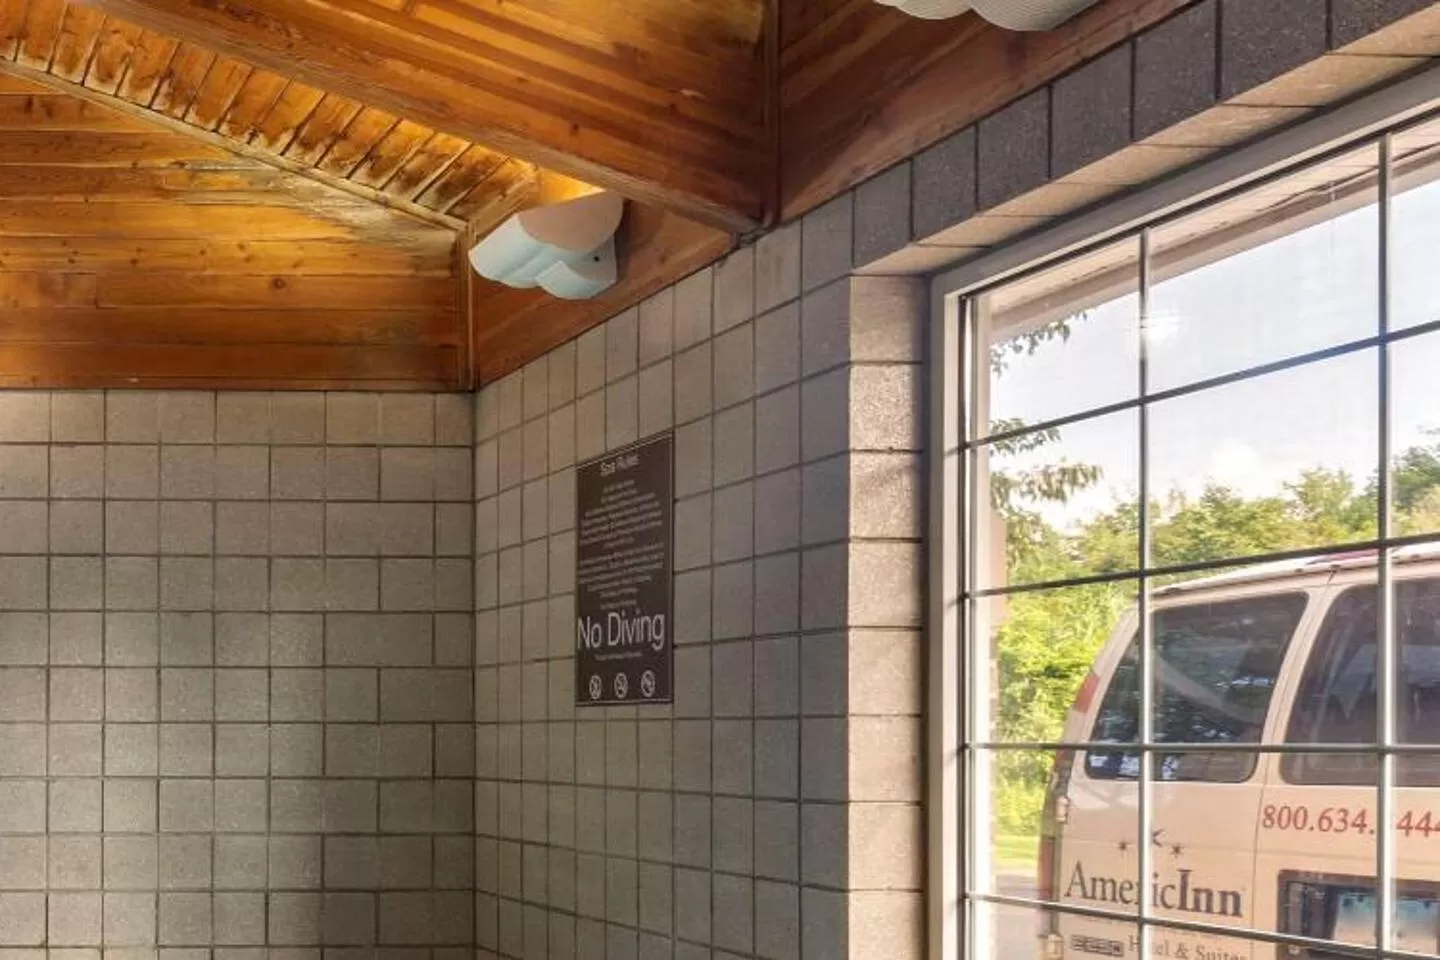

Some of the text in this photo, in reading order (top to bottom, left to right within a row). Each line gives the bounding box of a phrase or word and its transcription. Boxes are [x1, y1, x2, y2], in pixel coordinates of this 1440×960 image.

[577, 608, 665, 652] No Diving
[1064, 860, 1243, 918] AmeicInn
